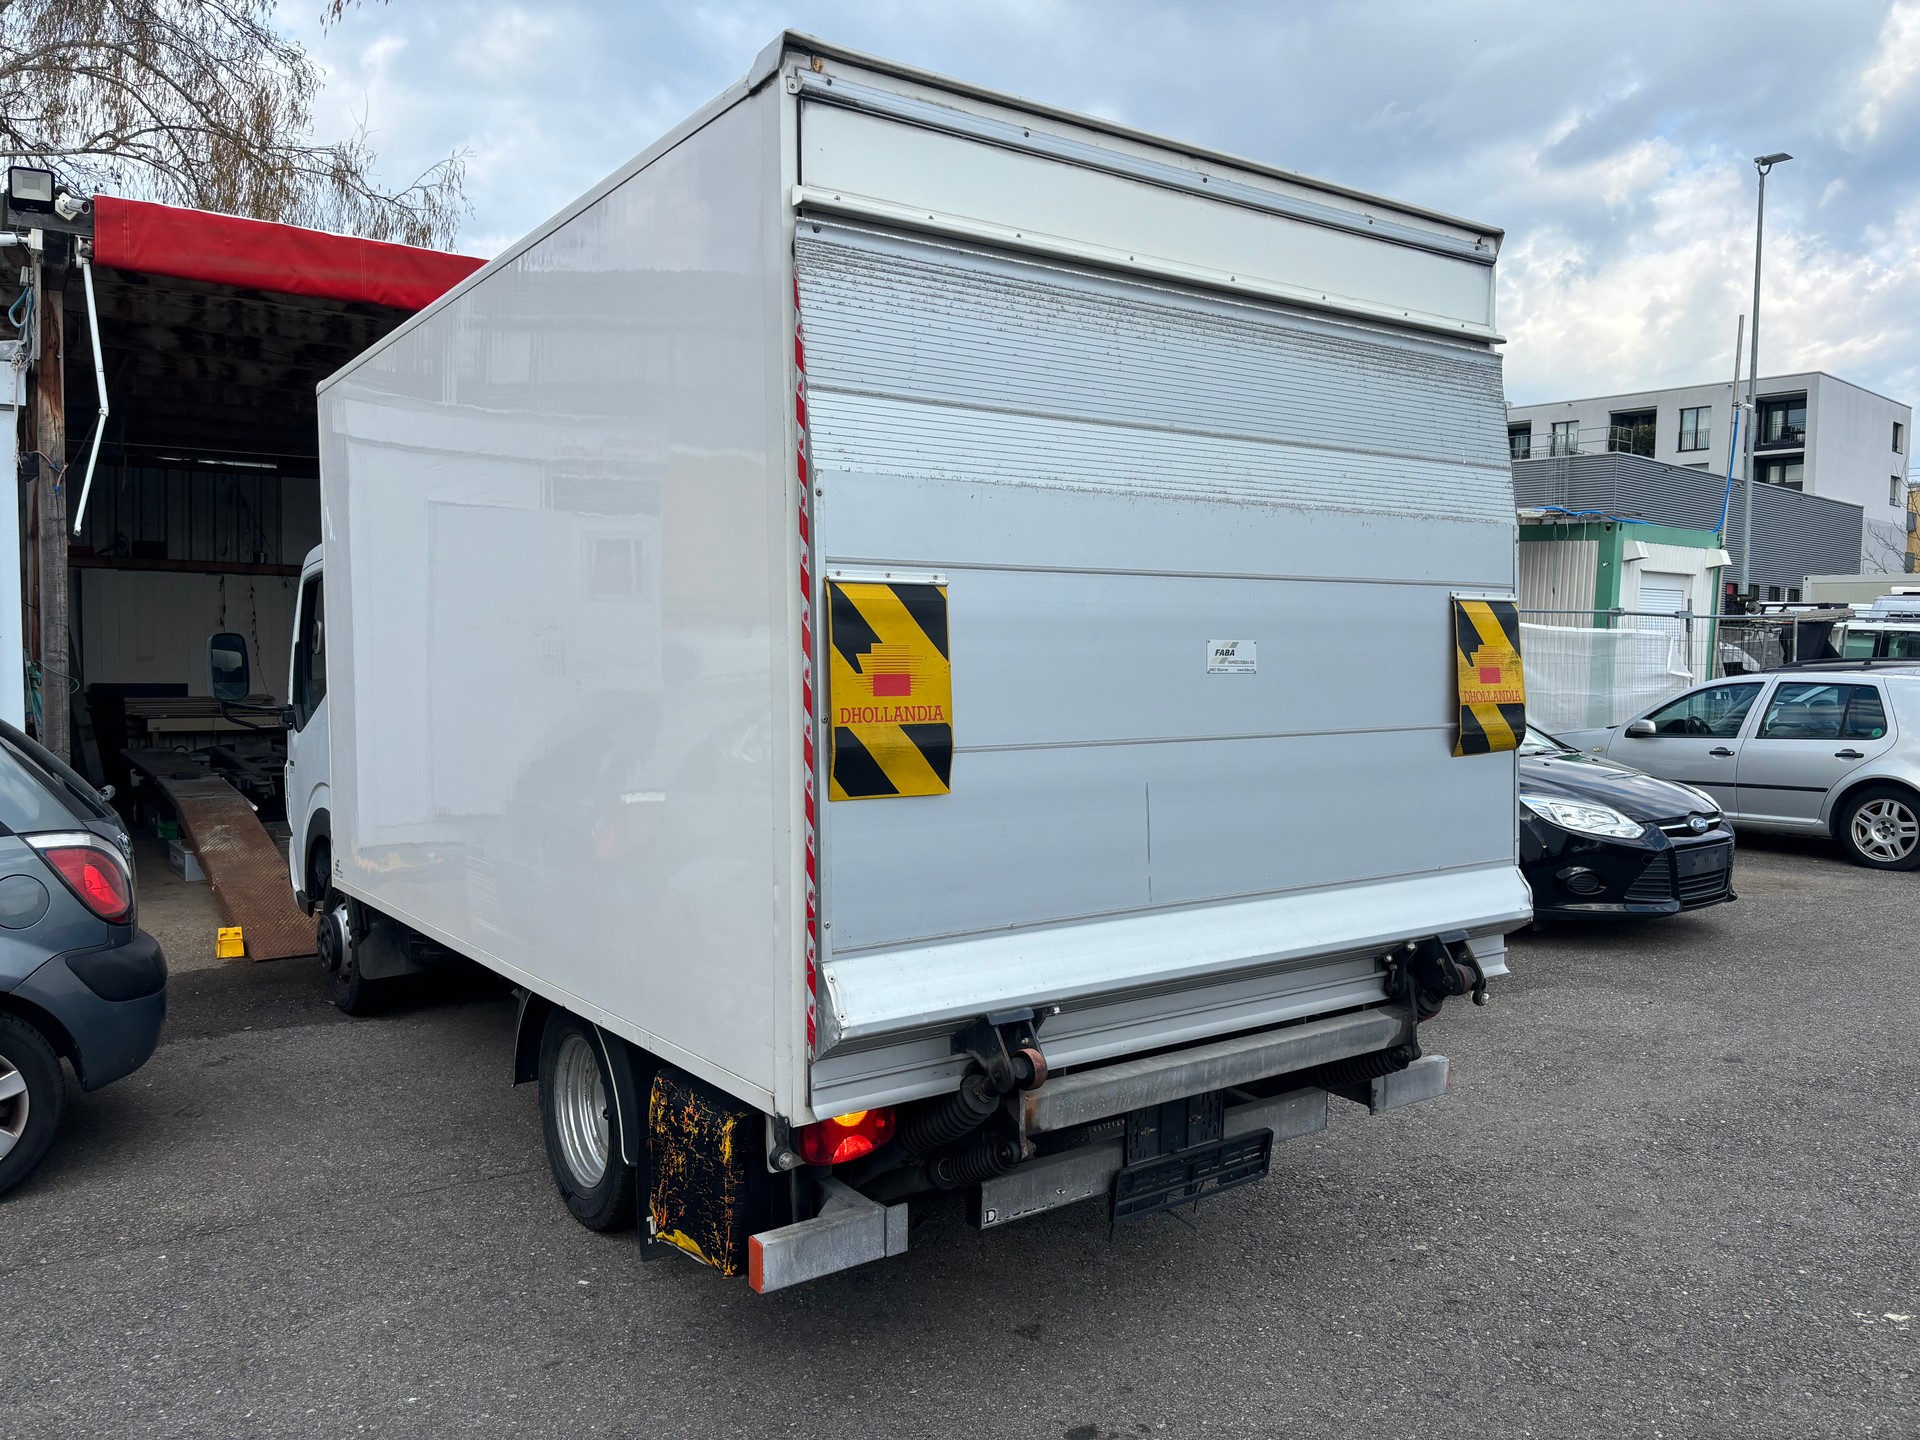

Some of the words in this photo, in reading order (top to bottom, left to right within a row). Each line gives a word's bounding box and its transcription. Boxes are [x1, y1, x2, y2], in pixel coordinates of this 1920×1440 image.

[1215, 648, 1235, 657] FABA
[1464, 689, 1521, 704] DHOLLANDIA
[840, 705, 944, 724] DHOLLANDIA
